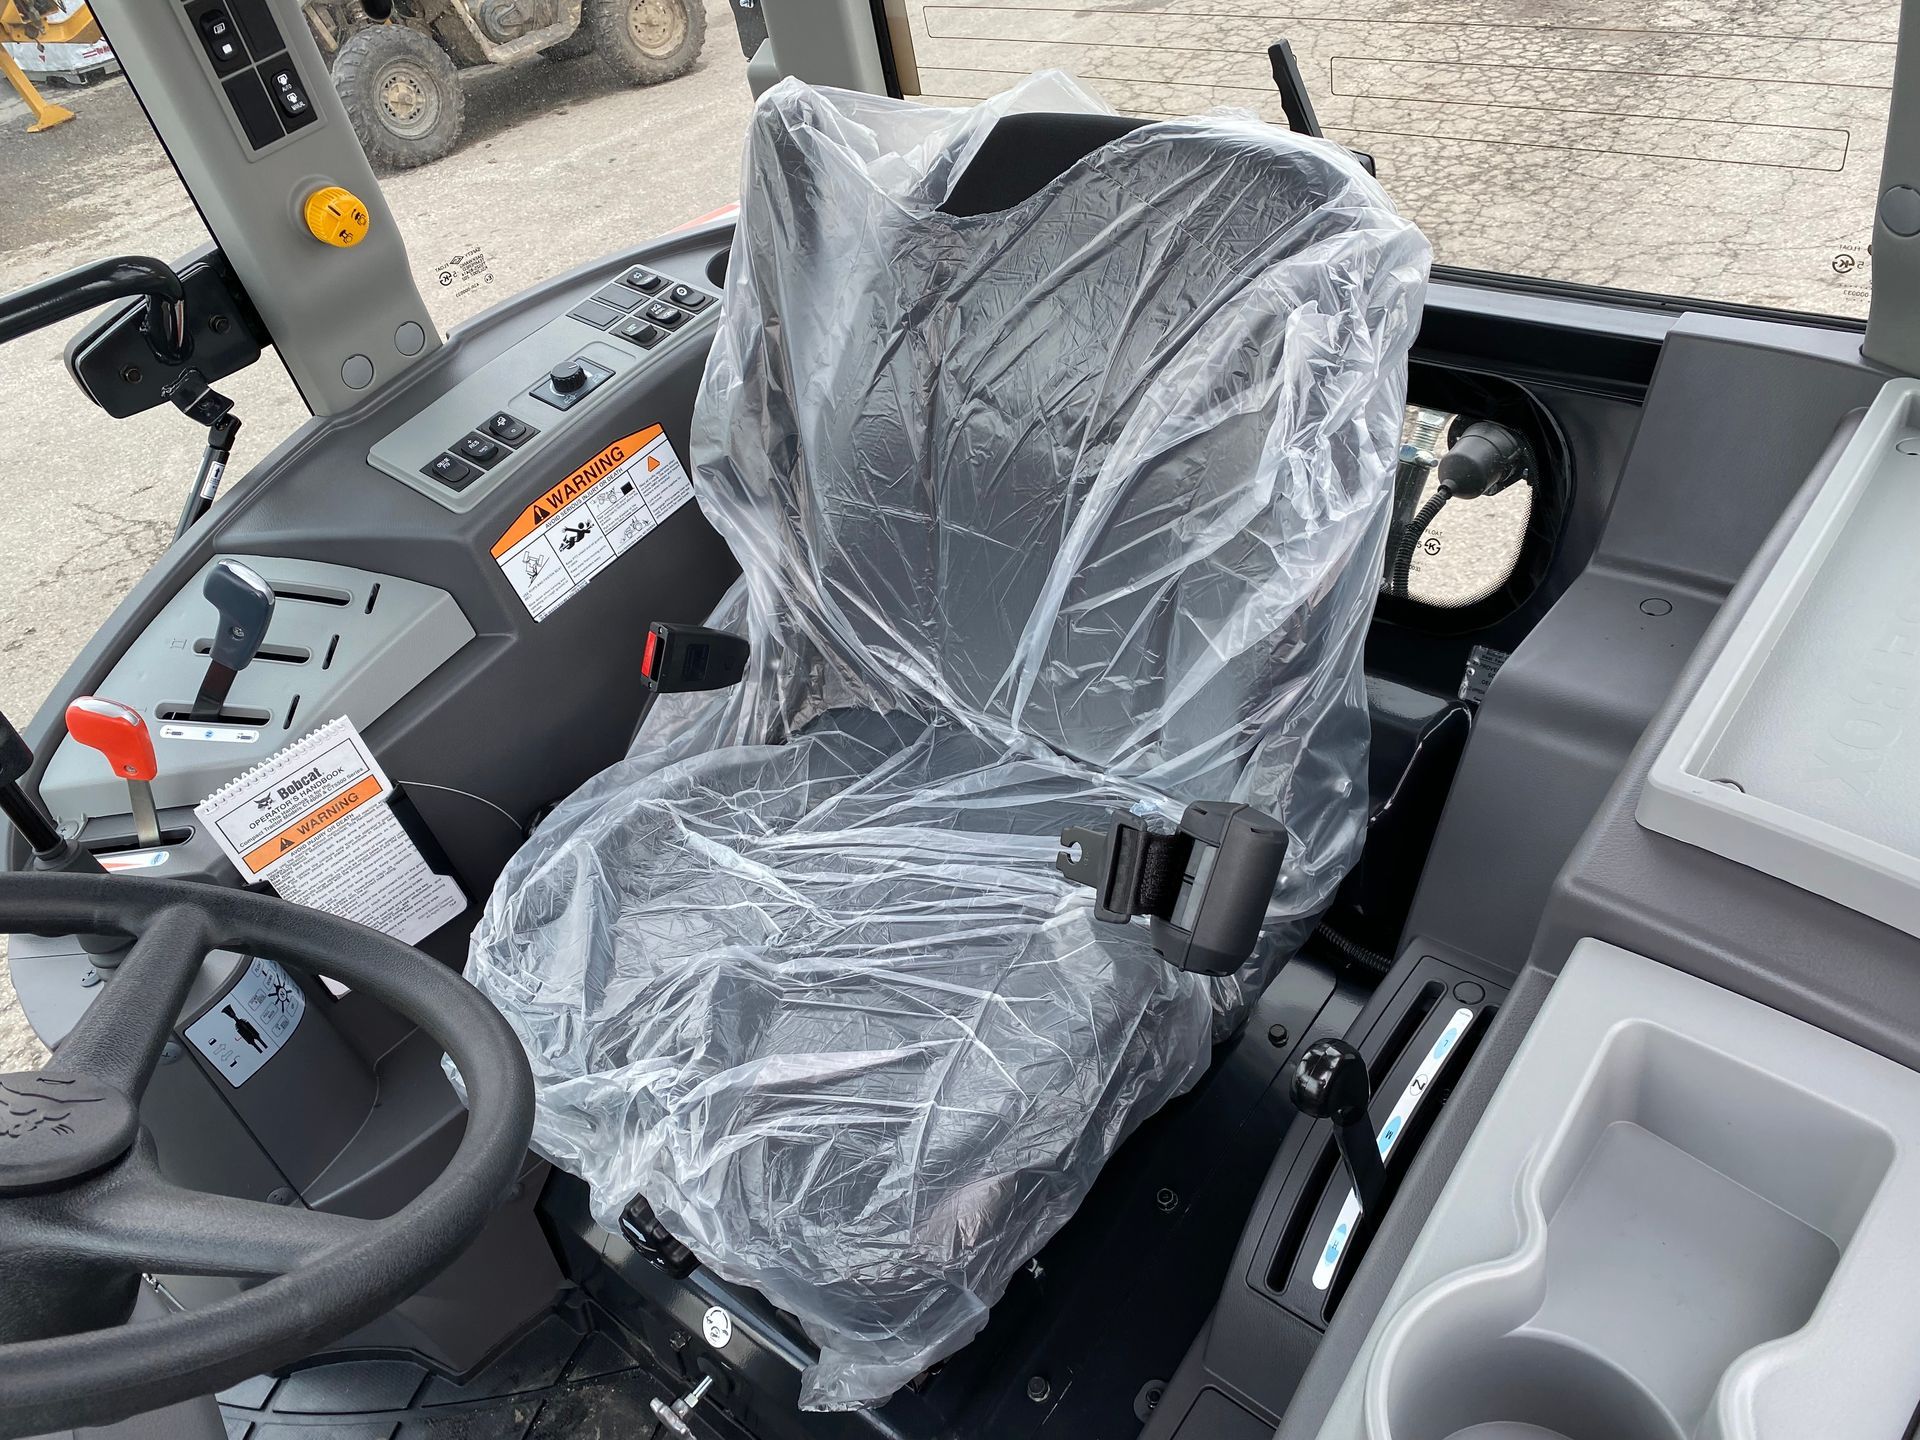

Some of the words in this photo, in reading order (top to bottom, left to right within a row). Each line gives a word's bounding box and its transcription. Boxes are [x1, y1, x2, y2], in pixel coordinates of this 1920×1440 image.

[282, 84, 292, 92] AUTO
[544, 514, 561, 529] AVOID
[559, 497, 582, 517] SERIOUS
[580, 484, 599, 501] INJURY
[598, 478, 607, 487] OR
[606, 466, 623, 482] DEATH
[545, 444, 625, 511] WARNING
[247, 794, 300, 830] OPERATOR'S
[298, 765, 344, 797] HANDBOOK
[276, 765, 322, 800] Bobcat
[238, 829, 264, 848] Compact
[263, 817, 283, 831] Tractor
[282, 805, 302, 820] Models
[345, 766, 364, 779] Series
[268, 813, 281, 824] This
[280, 796, 308, 816] Handbook
[295, 791, 359, 836] WARNING
[289, 843, 307, 856] AVOID
[306, 830, 327, 846] INJURY
[326, 824, 336, 832] OR
[335, 812, 354, 827] DEATH
